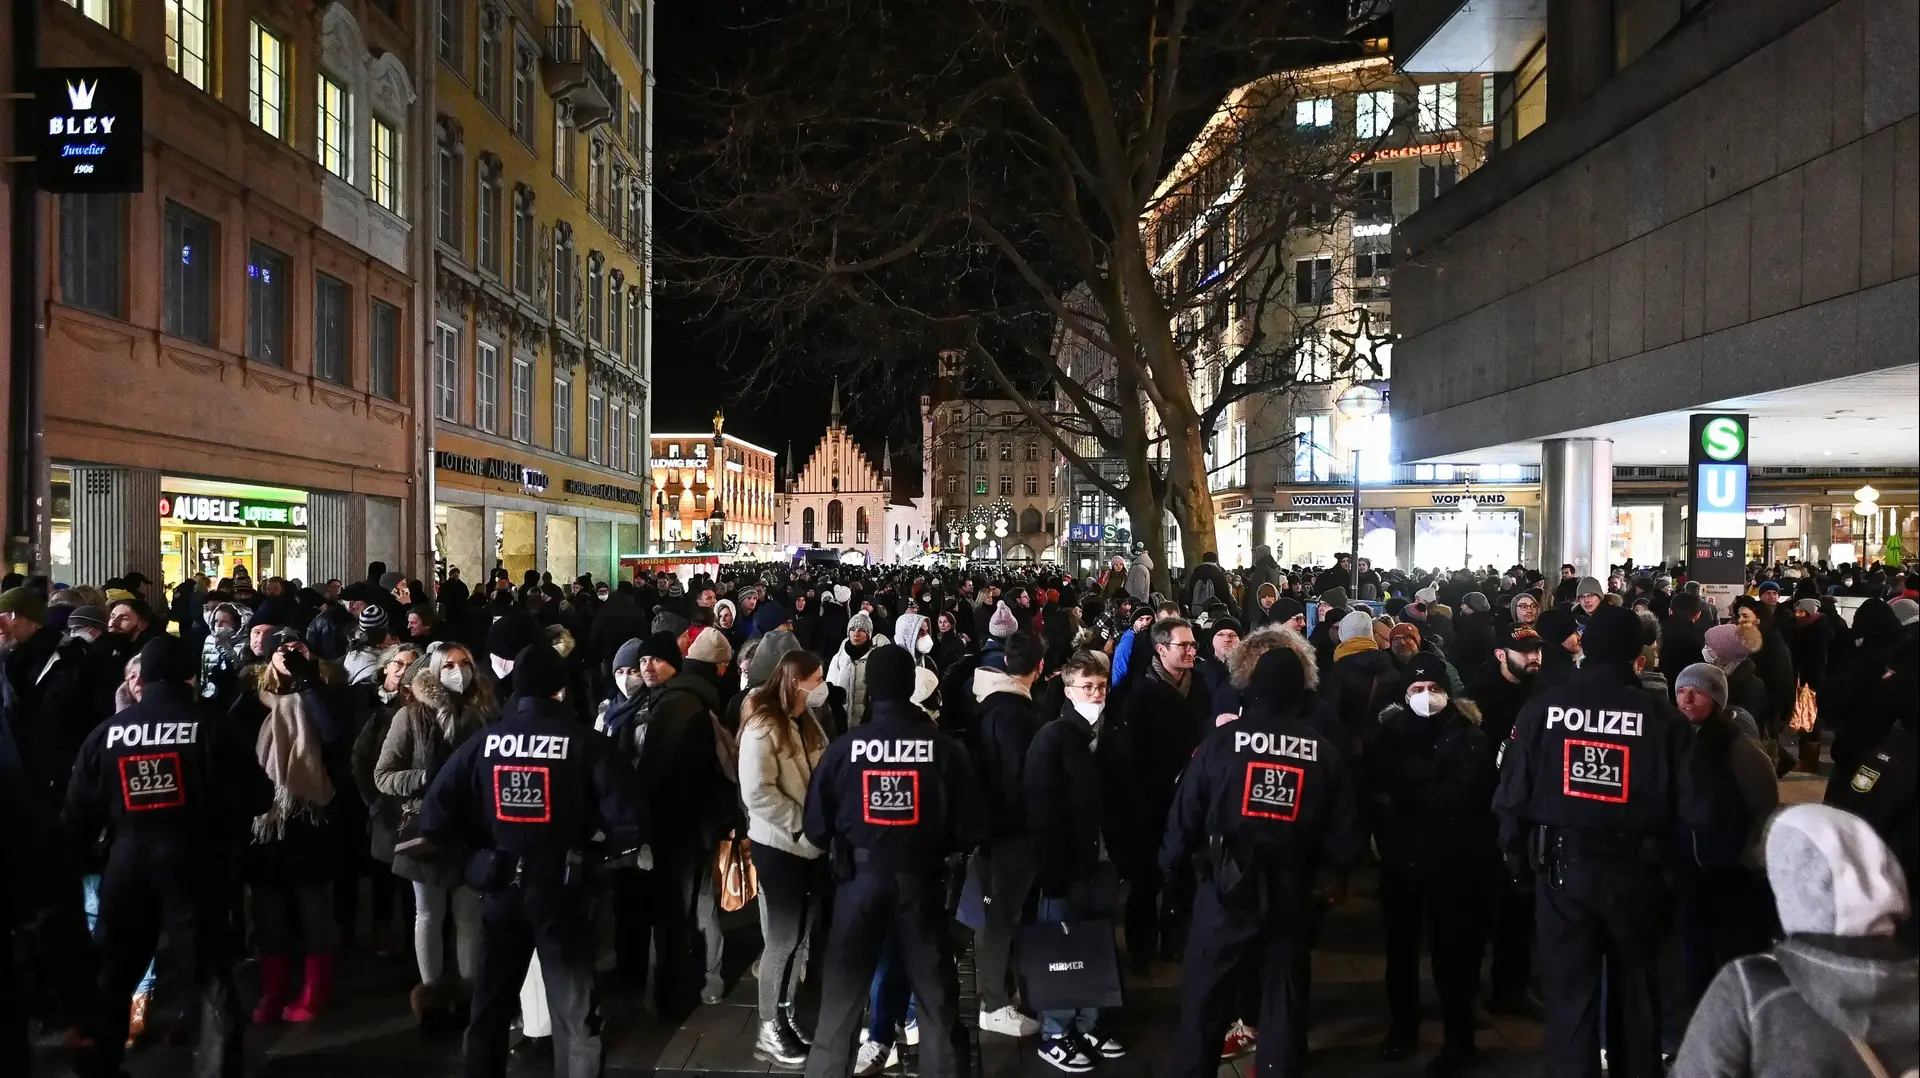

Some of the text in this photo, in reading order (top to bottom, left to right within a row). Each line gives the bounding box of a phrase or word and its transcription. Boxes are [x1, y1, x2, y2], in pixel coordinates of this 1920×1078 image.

[49, 116, 116, 135] BLEY
[61, 143, 106, 157] Juwelier
[1348, 140, 1464, 164] GCKENSPIEL
[73, 164, 94, 174] 1906
[1708, 419, 1740, 460] S
[441, 452, 484, 476] LOTTERIE
[650, 458, 708, 468] LUDWIG BECK
[1707, 469, 1736, 508] U
[173, 495, 240, 523] AUBELE
[1431, 494, 1506, 505] WORLAND
[1089, 525, 1116, 539] U S
[1726, 549, 1734, 558] S
[1546, 705, 1643, 736] POLIZEI
[106, 722, 199, 750] POLIZEI
[483, 734, 570, 760] POLIZEI
[850, 739, 934, 763] POLIZEI
[1234, 731, 1318, 762] POLIZEI
[1584, 746, 1609, 765] BY
[138, 758, 161, 776] BY
[1571, 761, 1621, 783] 6221
[129, 773, 176, 791] 6222
[511, 771, 532, 788] BY
[880, 776, 902, 792] BY
[1264, 768, 1287, 786] BY
[501, 787, 543, 804] 6222
[870, 791, 912, 807] 6221
[1252, 783, 1295, 803] 6221
